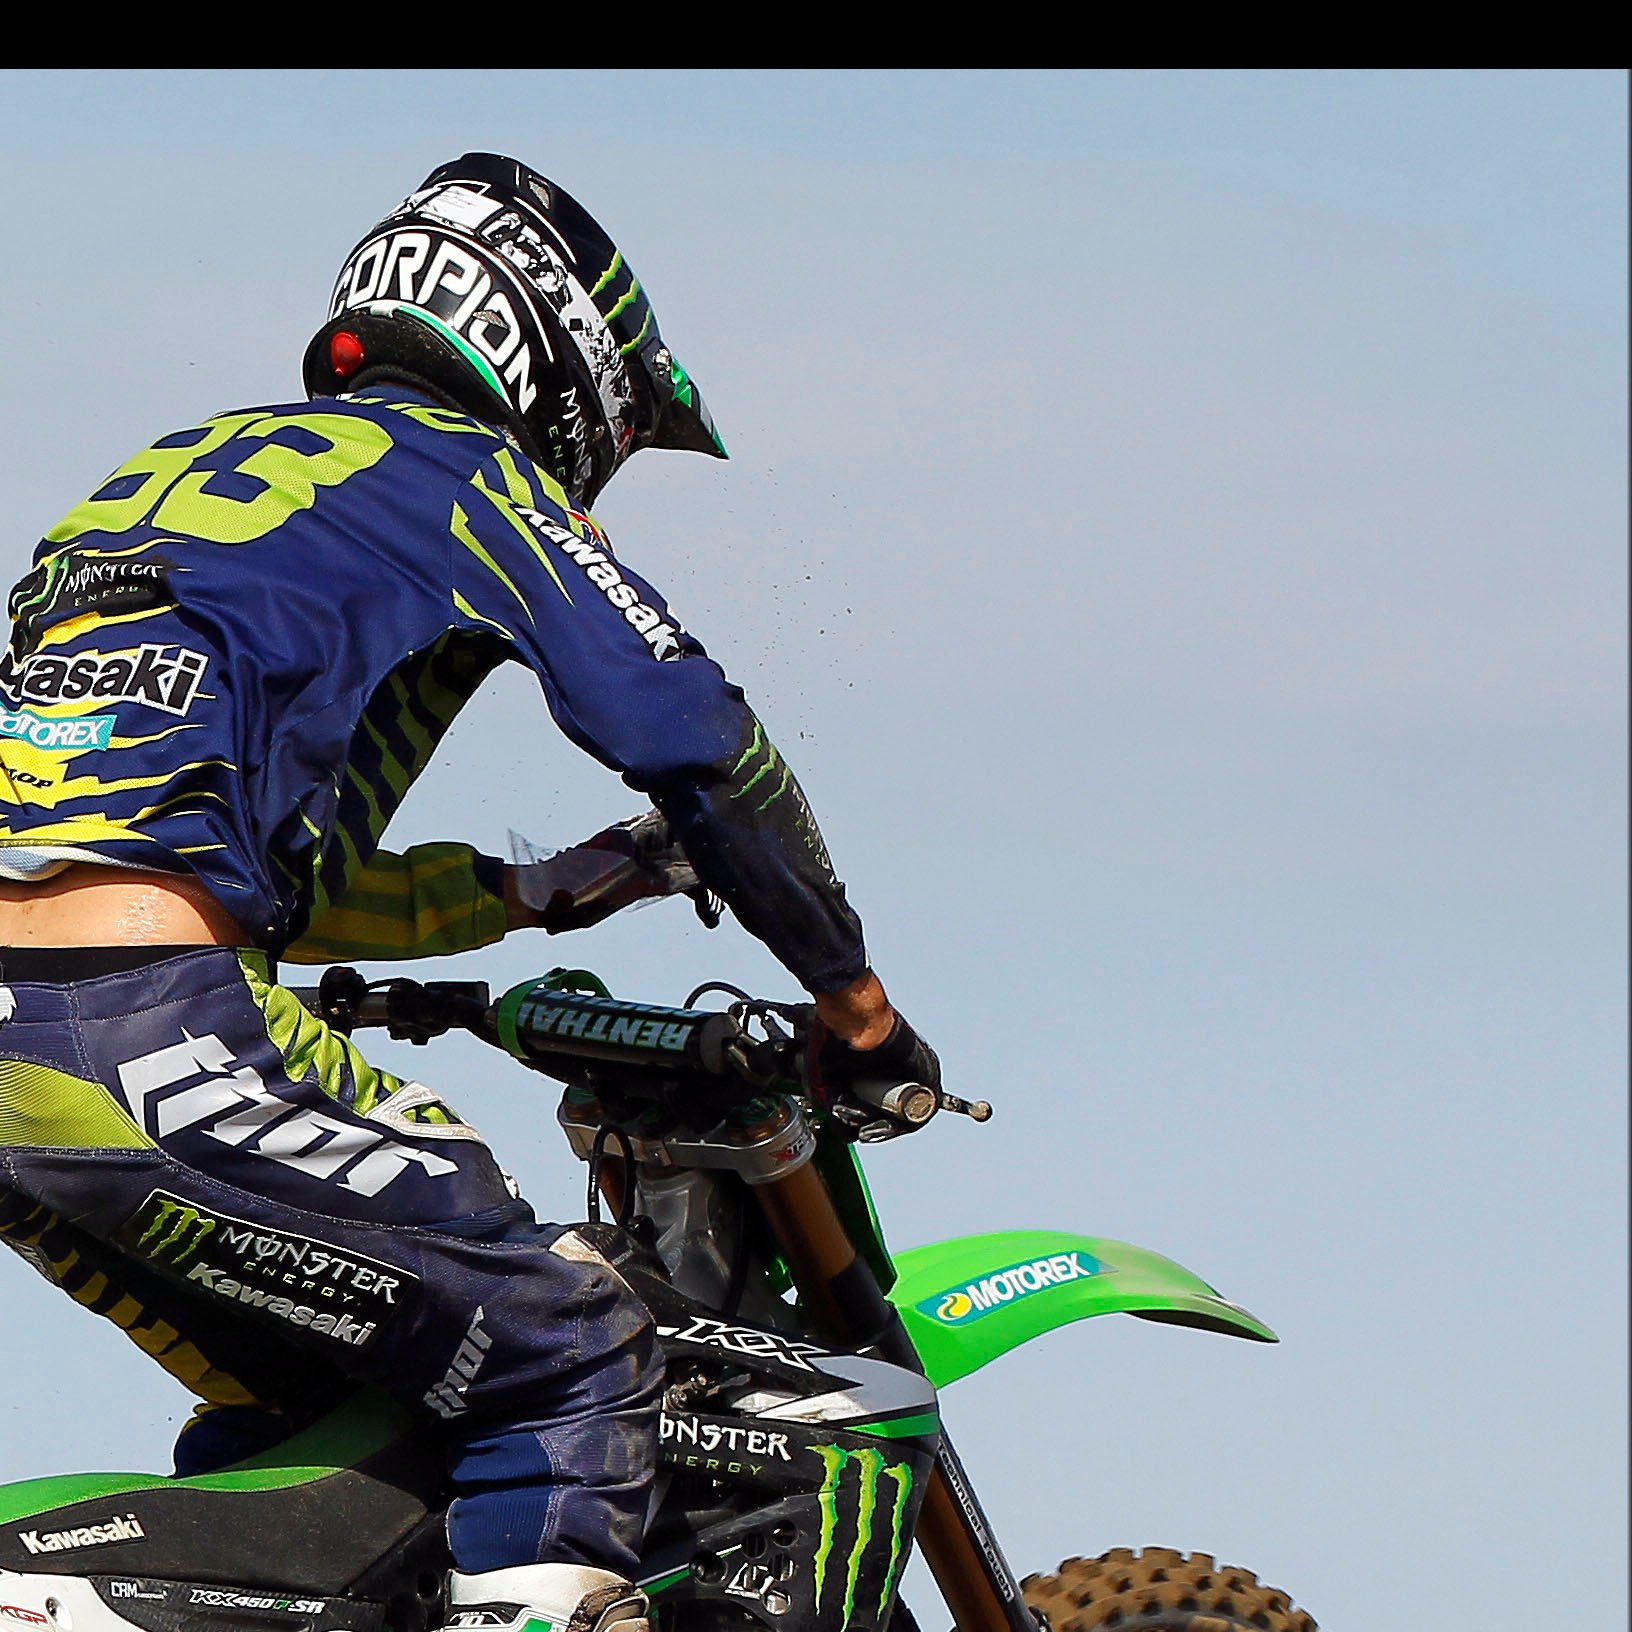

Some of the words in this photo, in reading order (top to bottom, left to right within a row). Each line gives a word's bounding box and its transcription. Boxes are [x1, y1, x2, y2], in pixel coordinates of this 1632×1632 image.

[328, 232, 537, 414] CORPION
[219, 1226, 400, 1304] MONSTER
[243, 1261, 355, 1302] ENERGY
[966, 1252, 1092, 1311] MOTOREX
[187, 1262, 377, 1346] Kawasaki
[659, 1413, 793, 1461] ONSTER
[665, 1452, 765, 1476] NERGY
[18, 1513, 145, 1555] Kawasaki
